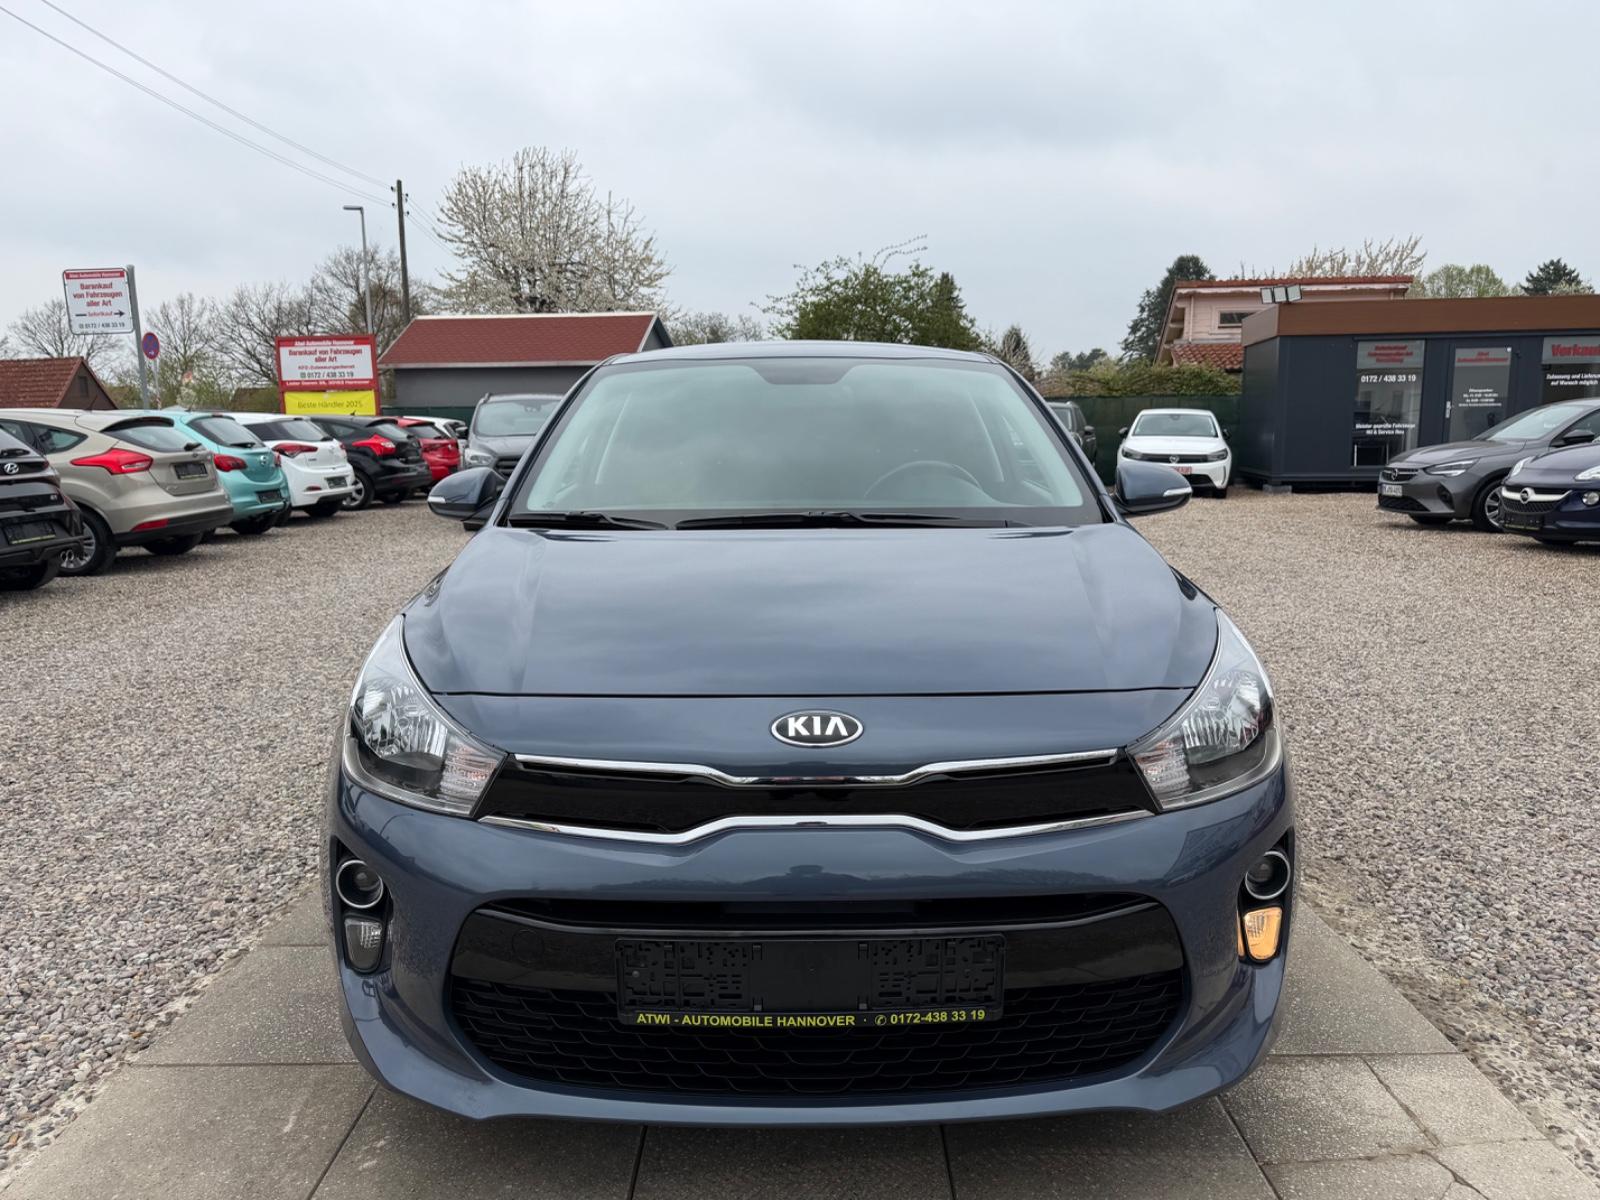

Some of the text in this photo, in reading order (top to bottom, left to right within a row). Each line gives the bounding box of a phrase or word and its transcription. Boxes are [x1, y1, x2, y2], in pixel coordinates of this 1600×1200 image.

[80, 282, 112, 290] Barankauf
[86, 291, 122, 299] Fahrzeugen
[330, 348, 362, 356] Fahrzeugen
[1552, 344, 1600, 356] Verkau
[1360, 374, 1378, 383] 0172
[1383, 374, 1397, 382] 438
[1397, 374, 1406, 382] 33
[297, 401, 316, 409] Beste
[787, 716, 849, 737] KIA
[636, 1013, 670, 1025] ATWI
[682, 1015, 773, 1027] AUTOMOBILE
[777, 1015, 856, 1027] HANNOVER
[890, 1012, 948, 1025] 0172-438
[951, 1011, 967, 1022] 33
[971, 1010, 986, 1021] 19
